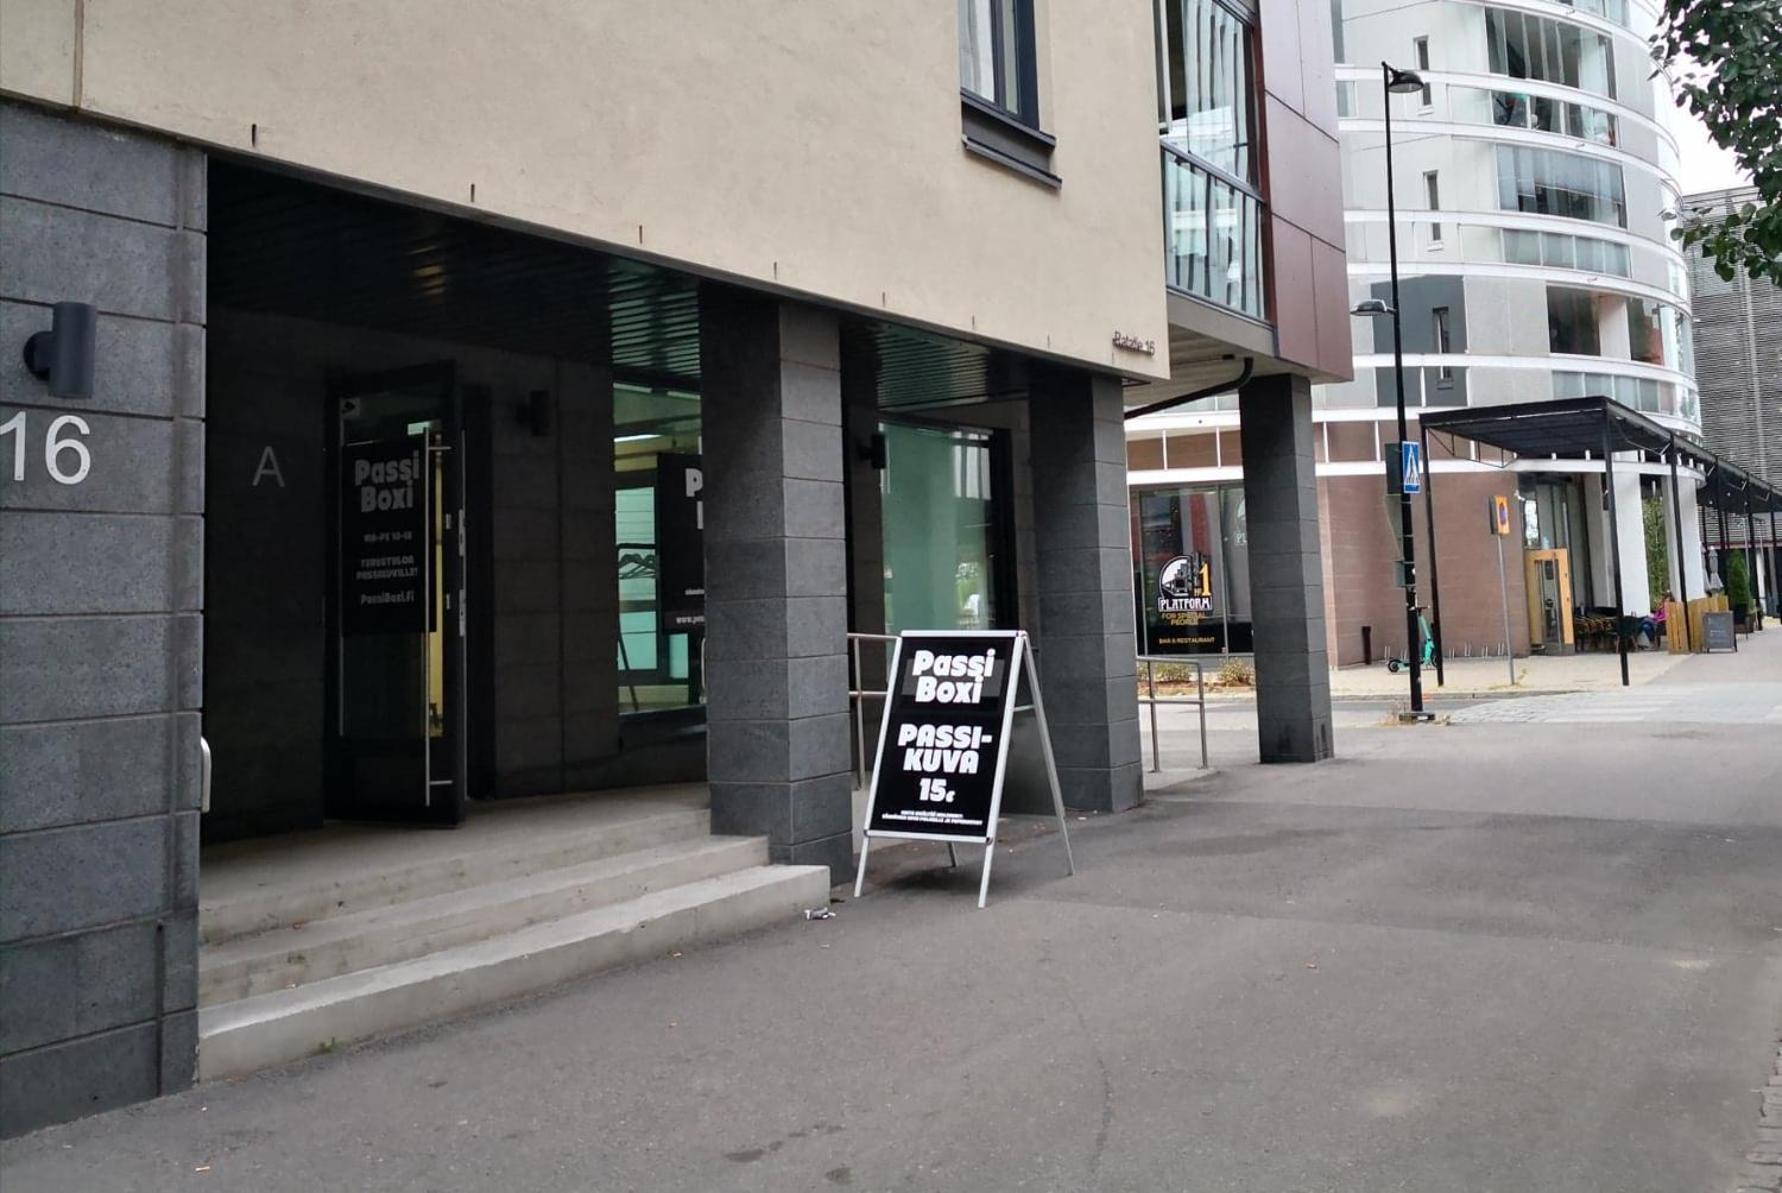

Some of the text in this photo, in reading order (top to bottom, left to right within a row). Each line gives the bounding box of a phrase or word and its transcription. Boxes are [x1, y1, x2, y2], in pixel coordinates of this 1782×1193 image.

[0, 411, 91, 484] 16
[252, 446, 285, 487] A
[354, 449, 420, 487] Passi
[360, 480, 414, 513] Boxi
[1160, 597, 1210, 610] PLATFORM
[912, 648, 996, 677] Passi
[915, 676, 984, 704] Boxi
[897, 723, 993, 750] PASSI-
[903, 749, 980, 774] KUVA
